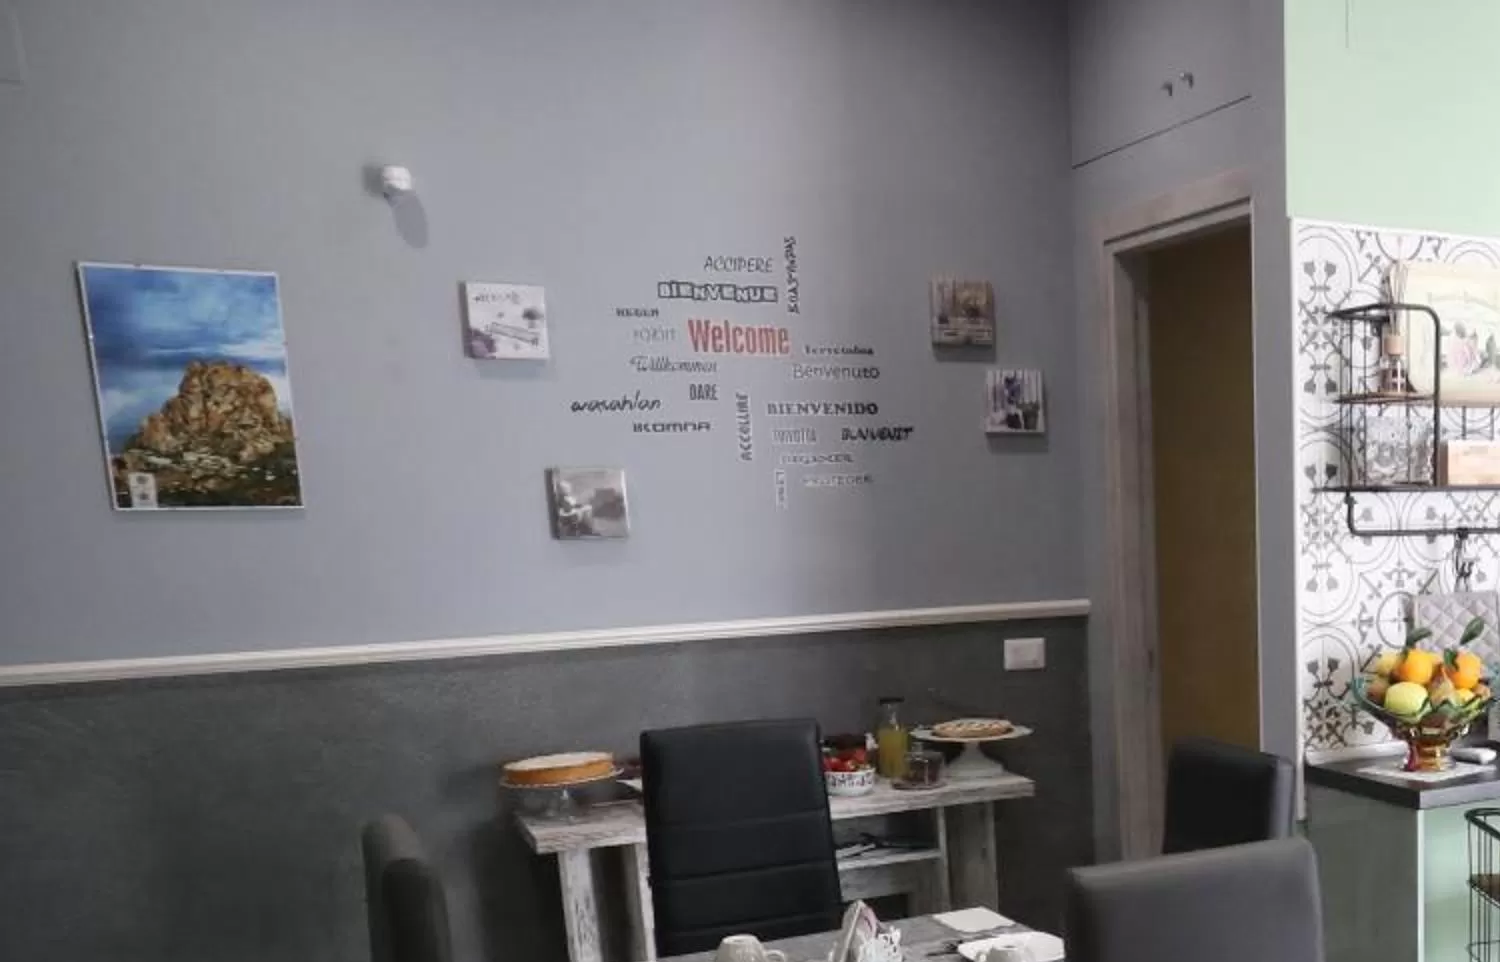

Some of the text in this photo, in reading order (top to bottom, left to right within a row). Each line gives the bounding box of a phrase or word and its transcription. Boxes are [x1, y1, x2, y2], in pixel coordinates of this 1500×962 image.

[688, 319, 791, 356] Welcome
[793, 363, 880, 380] Benvenuto
[689, 383, 718, 401] DARE
[767, 402, 878, 416] BIENVENIDO
